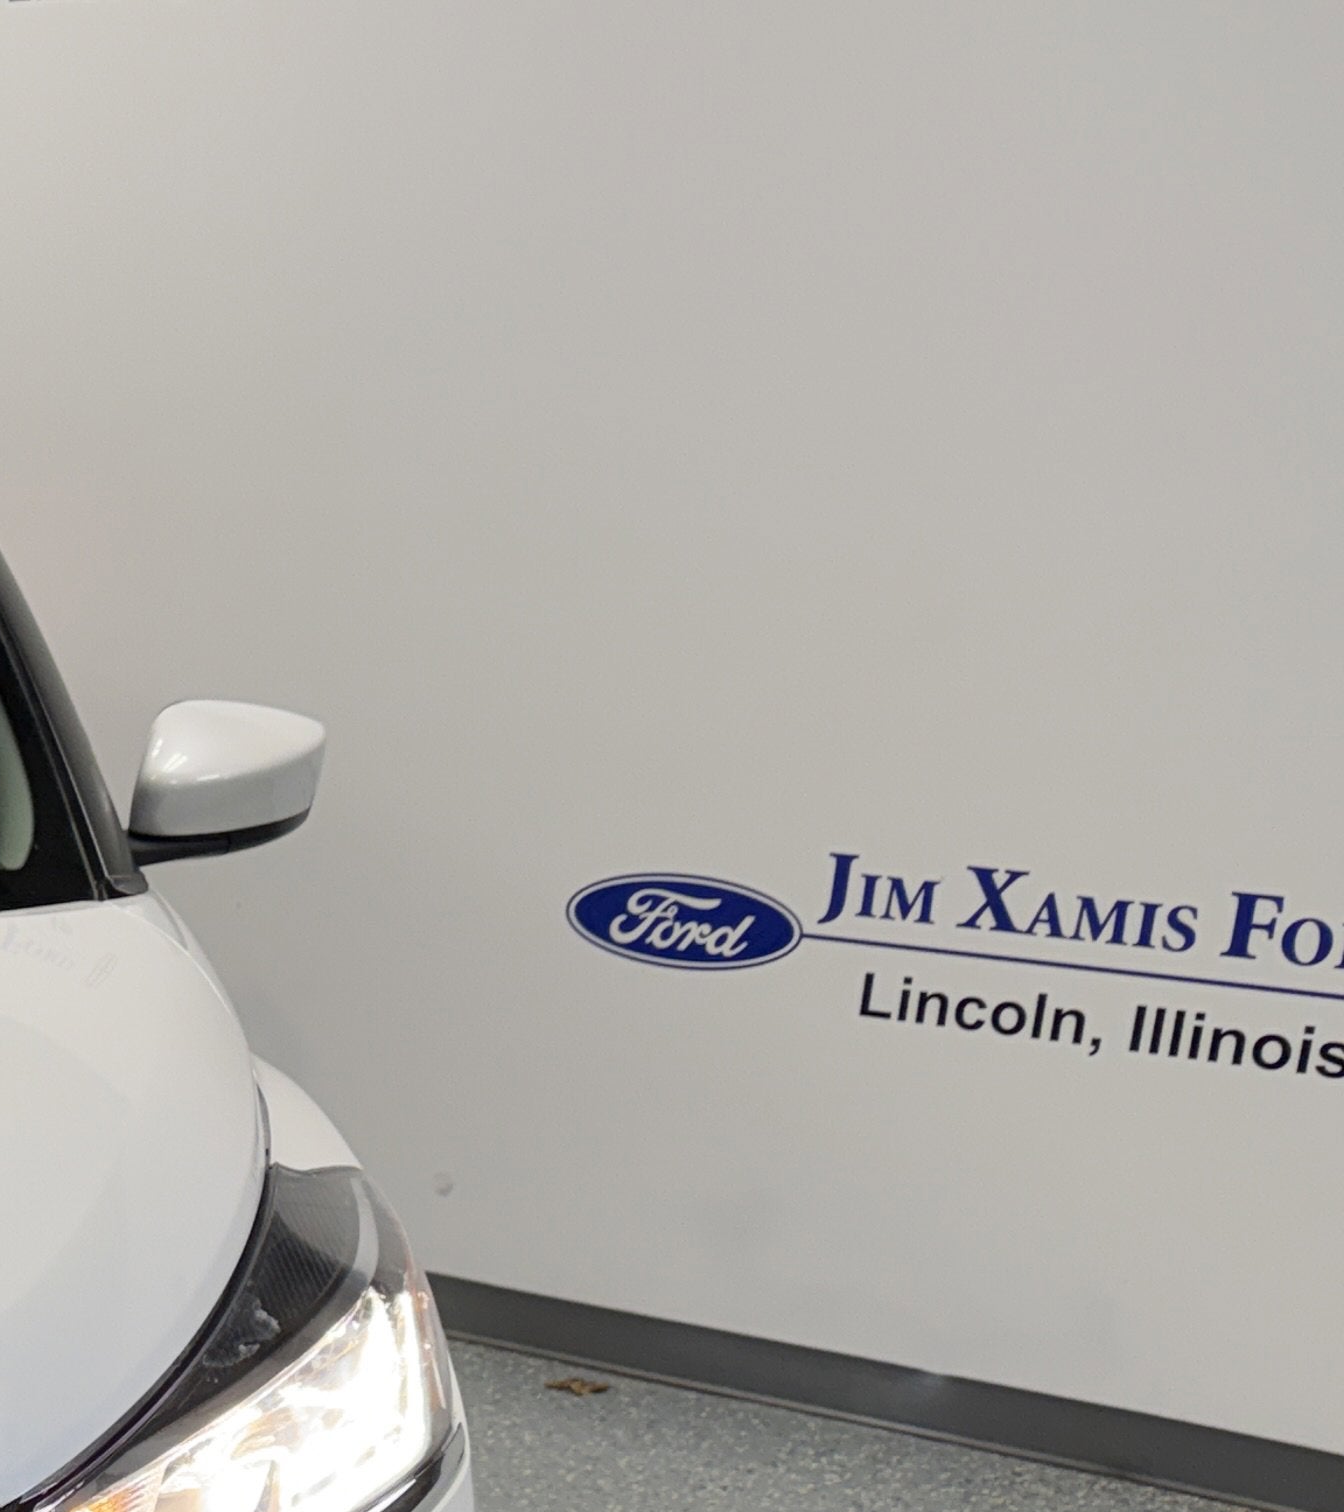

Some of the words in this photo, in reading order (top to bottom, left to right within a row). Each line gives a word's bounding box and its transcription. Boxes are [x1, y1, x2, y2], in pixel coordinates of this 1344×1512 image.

[609, 887, 750, 959] Ford
[817, 852, 942, 925] JIM
[956, 865, 1200, 954] XAMIS
[1219, 890, 1344, 970] FO
[858, 971, 1105, 1056] Lincoln,
[1127, 1004, 1344, 1079] Illinois
